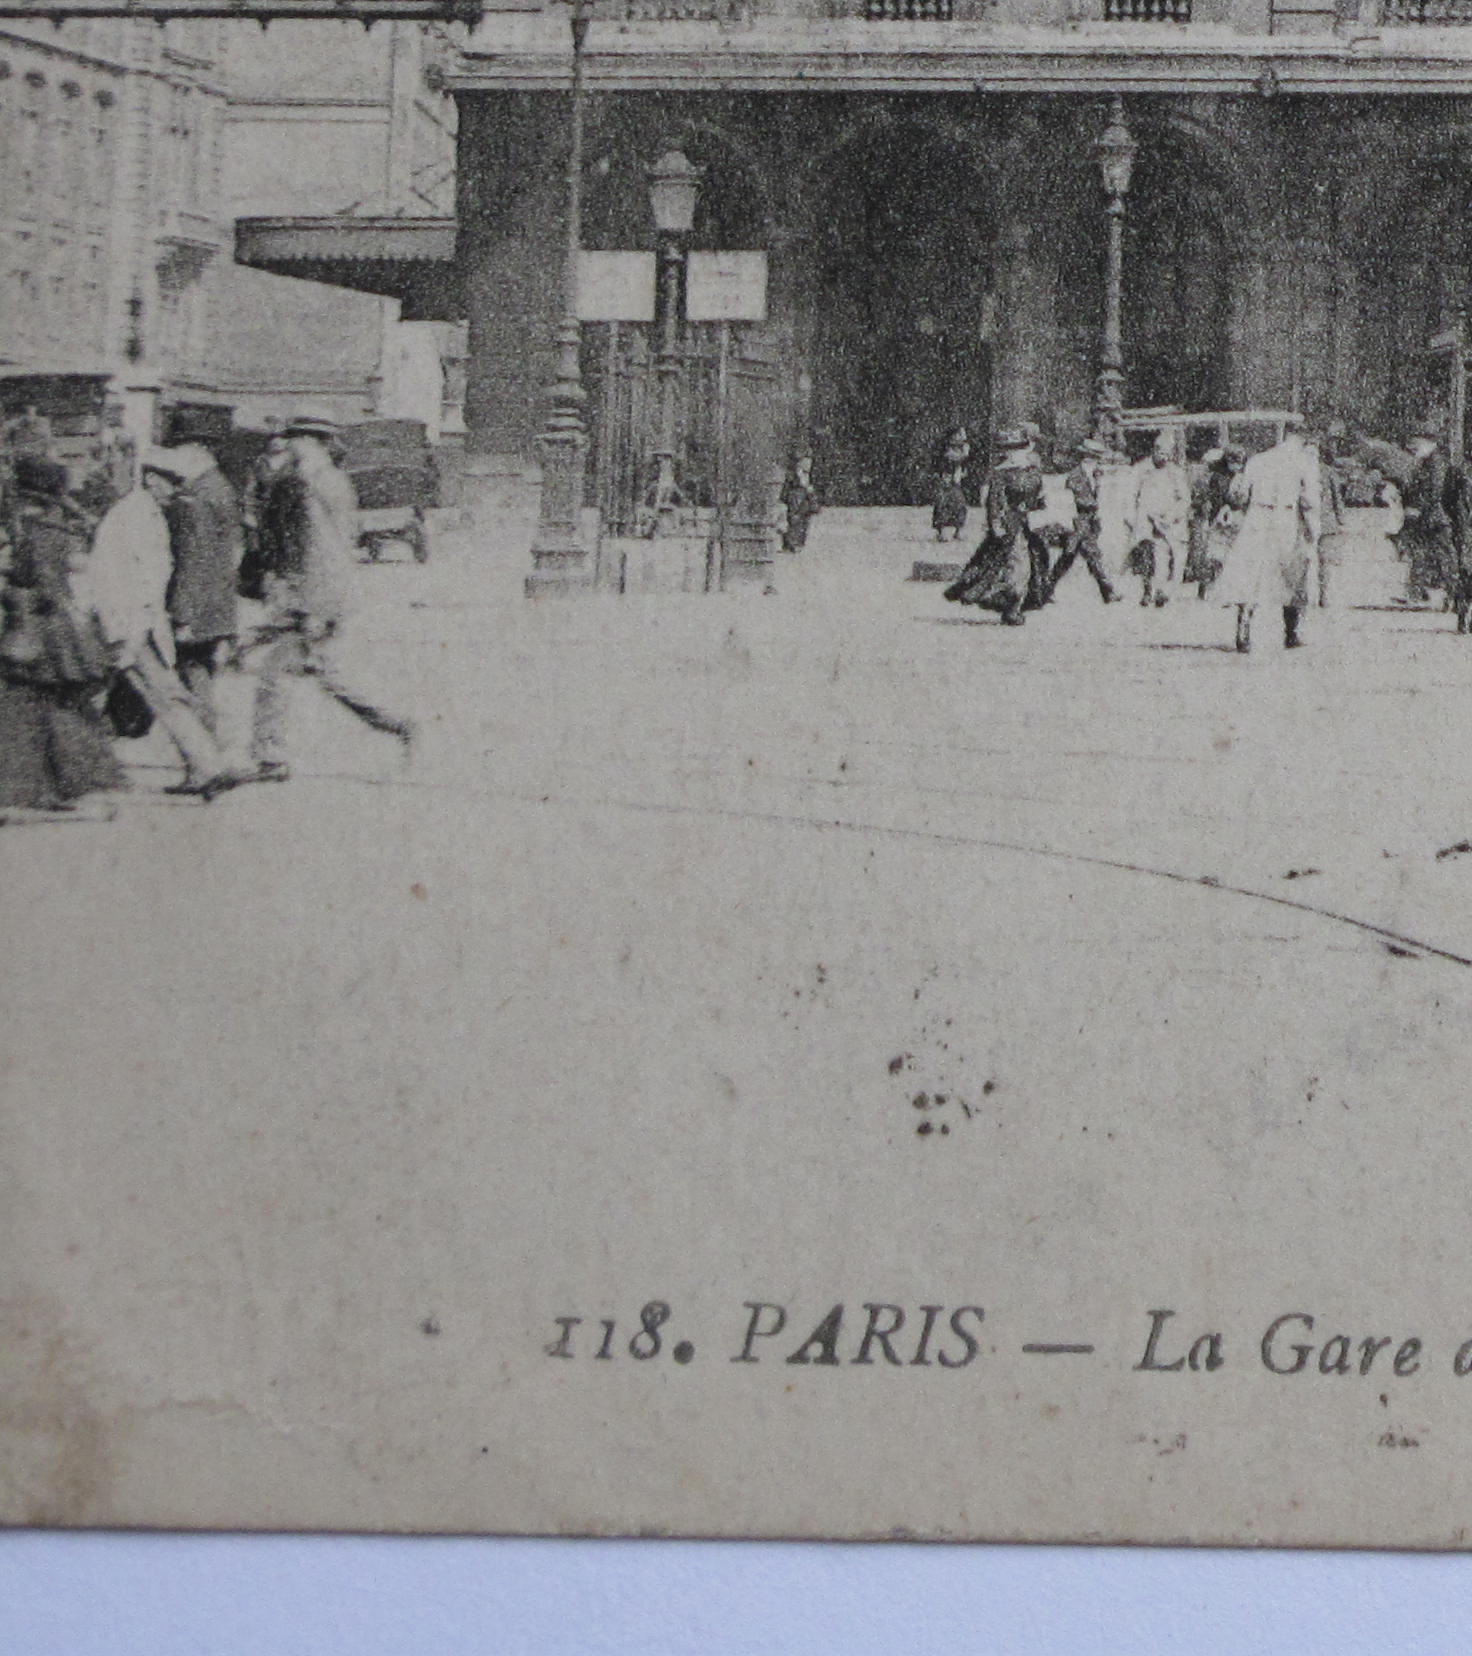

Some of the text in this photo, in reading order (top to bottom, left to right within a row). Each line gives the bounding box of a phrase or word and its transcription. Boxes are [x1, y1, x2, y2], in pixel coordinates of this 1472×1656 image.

[542, 1299, 696, 1366] 118.
[729, 1301, 987, 1369] PARIS
[1131, 1308, 1225, 1373] La
[1259, 1311, 1424, 1377] Gare
